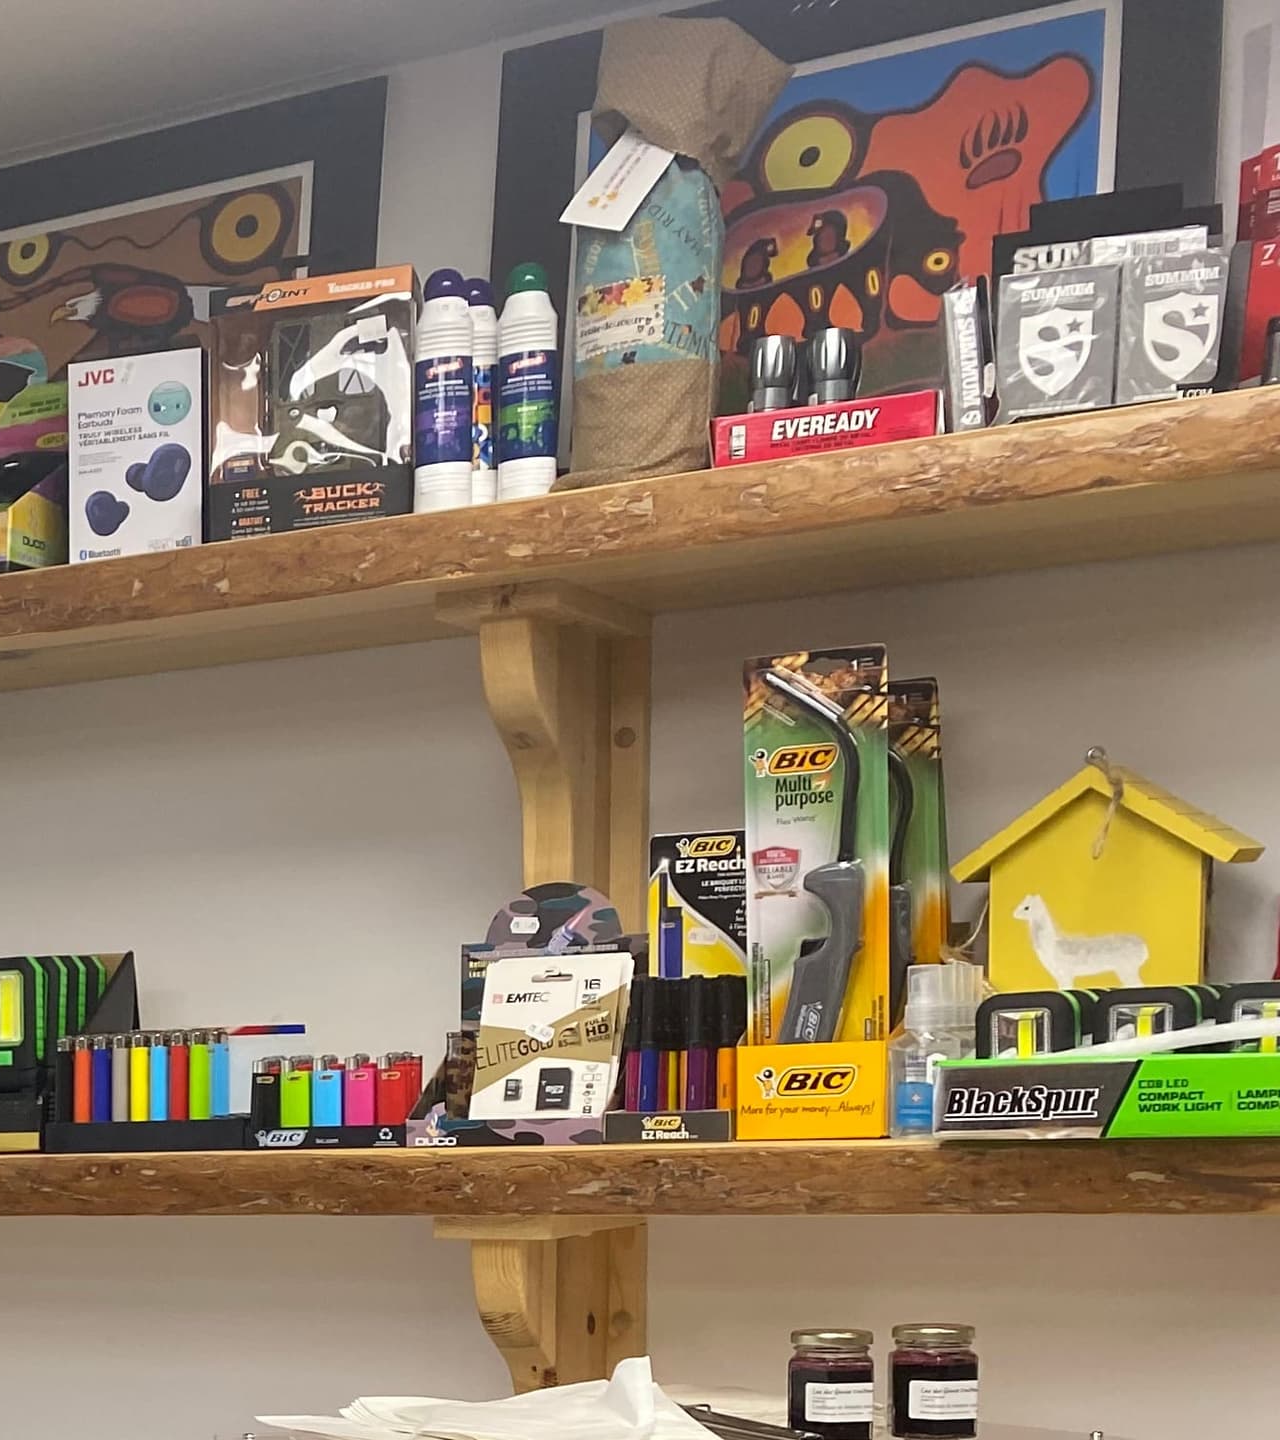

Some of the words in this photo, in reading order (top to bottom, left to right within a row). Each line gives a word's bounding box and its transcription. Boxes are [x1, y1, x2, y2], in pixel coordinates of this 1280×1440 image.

[1145, 266, 1220, 287] SUMMUM
[78, 368, 115, 387] JVC
[771, 407, 880, 441] EVEREADY
[311, 482, 370, 500] BUCK
[303, 497, 380, 514] TRACKER
[776, 774, 812, 794] Multi
[776, 788, 834, 811] purpose
[675, 860, 695, 873] EZ
[506, 991, 551, 1004] EMTEC
[586, 1022, 609, 1038] HD
[1139, 1079, 1163, 1089] COB
[1165, 1078, 1189, 1088] LED
[946, 1084, 1100, 1119] BlackSpur
[1138, 1090, 1204, 1101] COMPACT
[765, 1102, 779, 1114] for
[780, 1105, 799, 1118] your
[1139, 1102, 1184, 1113] WORK
[1188, 1101, 1223, 1112] LIGHT
[415, 1136, 457, 1147] DUCO
